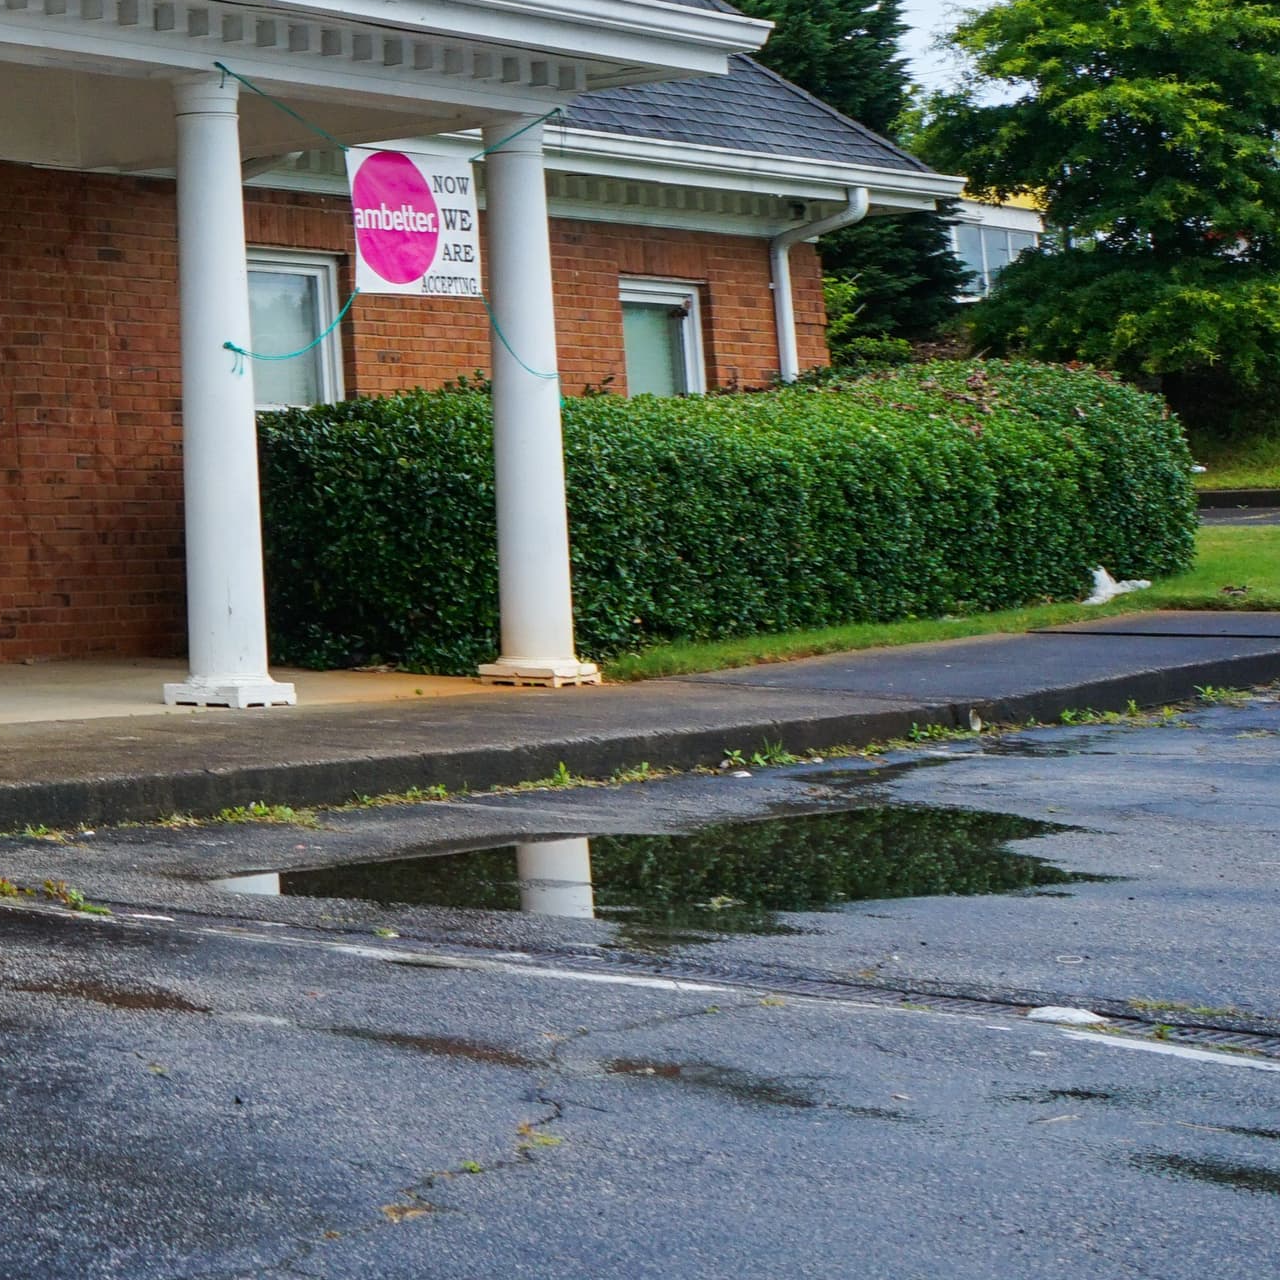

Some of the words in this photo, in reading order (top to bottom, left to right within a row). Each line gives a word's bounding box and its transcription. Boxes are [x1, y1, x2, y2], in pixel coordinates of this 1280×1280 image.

[432, 175, 469, 195] NOW
[355, 202, 438, 232] ambetter.
[441, 208, 472, 231] WE
[442, 244, 474, 262] ARE
